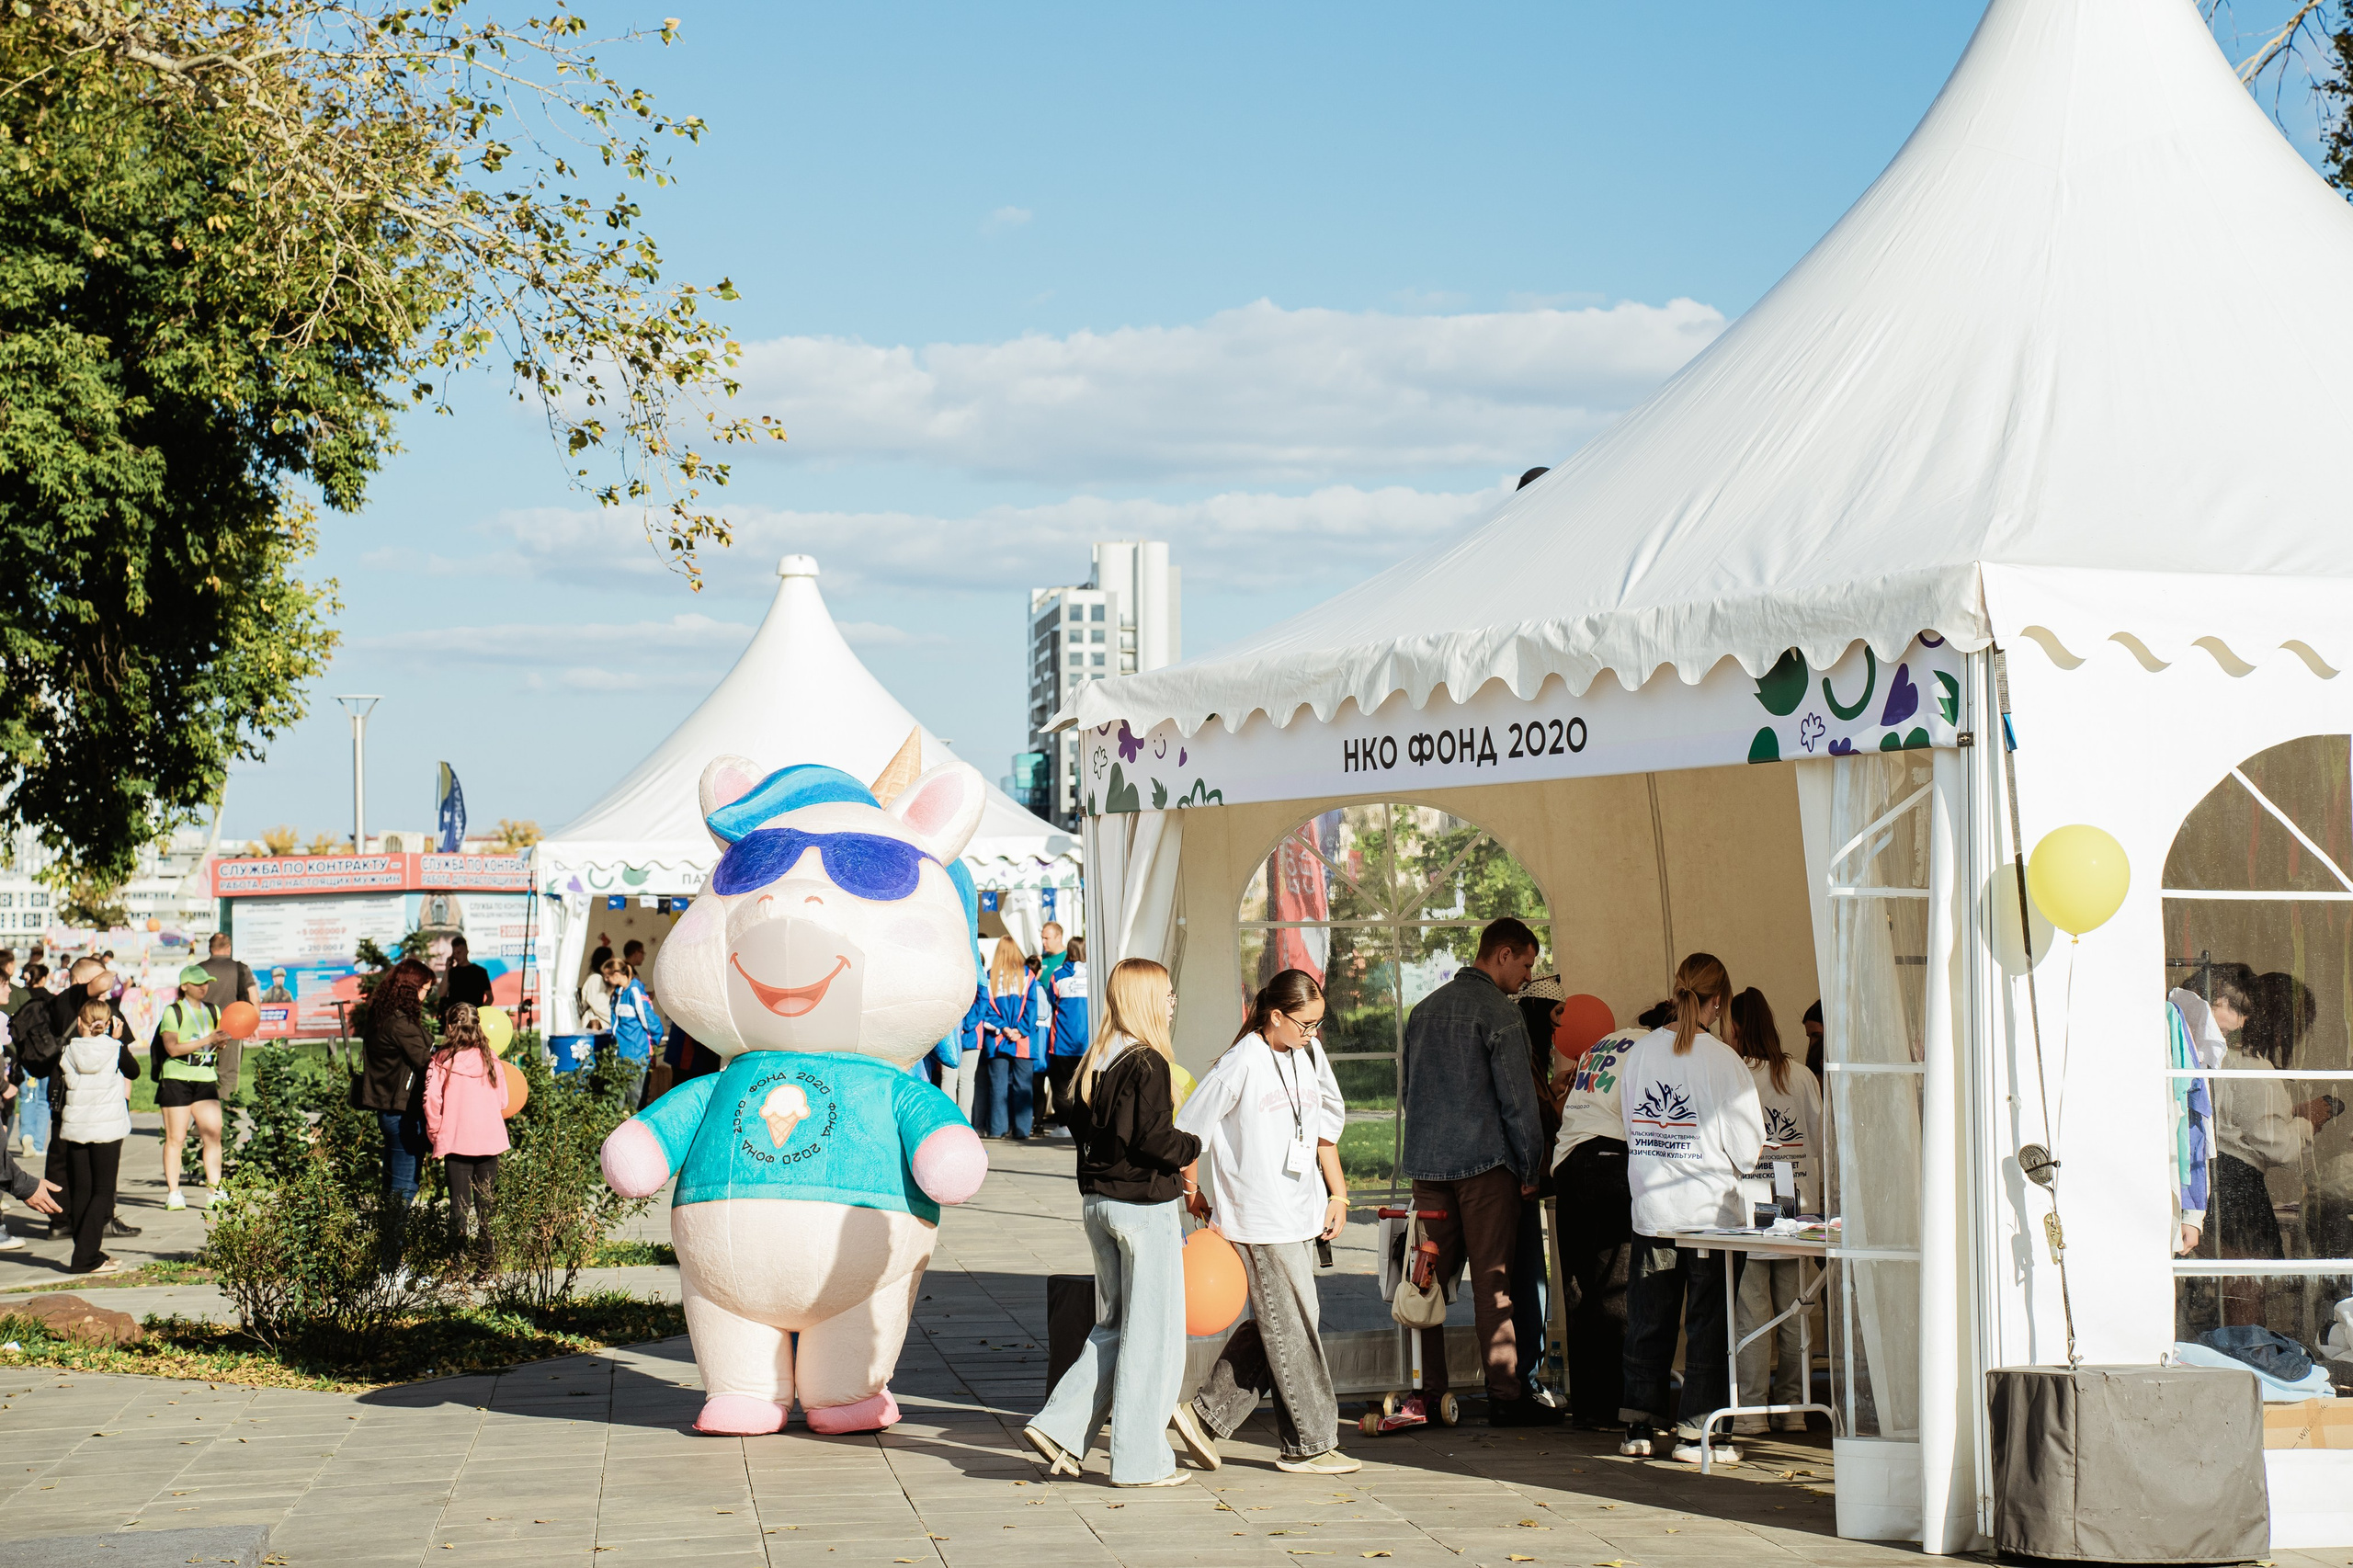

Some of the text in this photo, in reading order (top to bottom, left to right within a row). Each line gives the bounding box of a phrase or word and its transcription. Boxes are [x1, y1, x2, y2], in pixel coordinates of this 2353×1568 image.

[1344, 716, 1587, 773] НКО ФОНД 2020
[220, 864, 279, 876] СЛУЖБА
[283, 862, 303, 873] ПО
[308, 859, 388, 871] КОНТРАКТУ
[423, 858, 529, 872] СЛУЖБА ПО КОНТРАК
[220, 874, 401, 890] РАБОТА ДЛЯ НАСТОЯЩИХ МУЖЧИН
[1574, 1071, 1617, 1094] ИКИ
[733, 1072, 837, 1165] ФОНД 2020 ФОНД 2020 ФОНД 2020
[1635, 1139, 1691, 1150] УНИВЕРСИТЕТ
[1629, 1149, 1666, 1158] ИЗИЧЕСКОЙ
